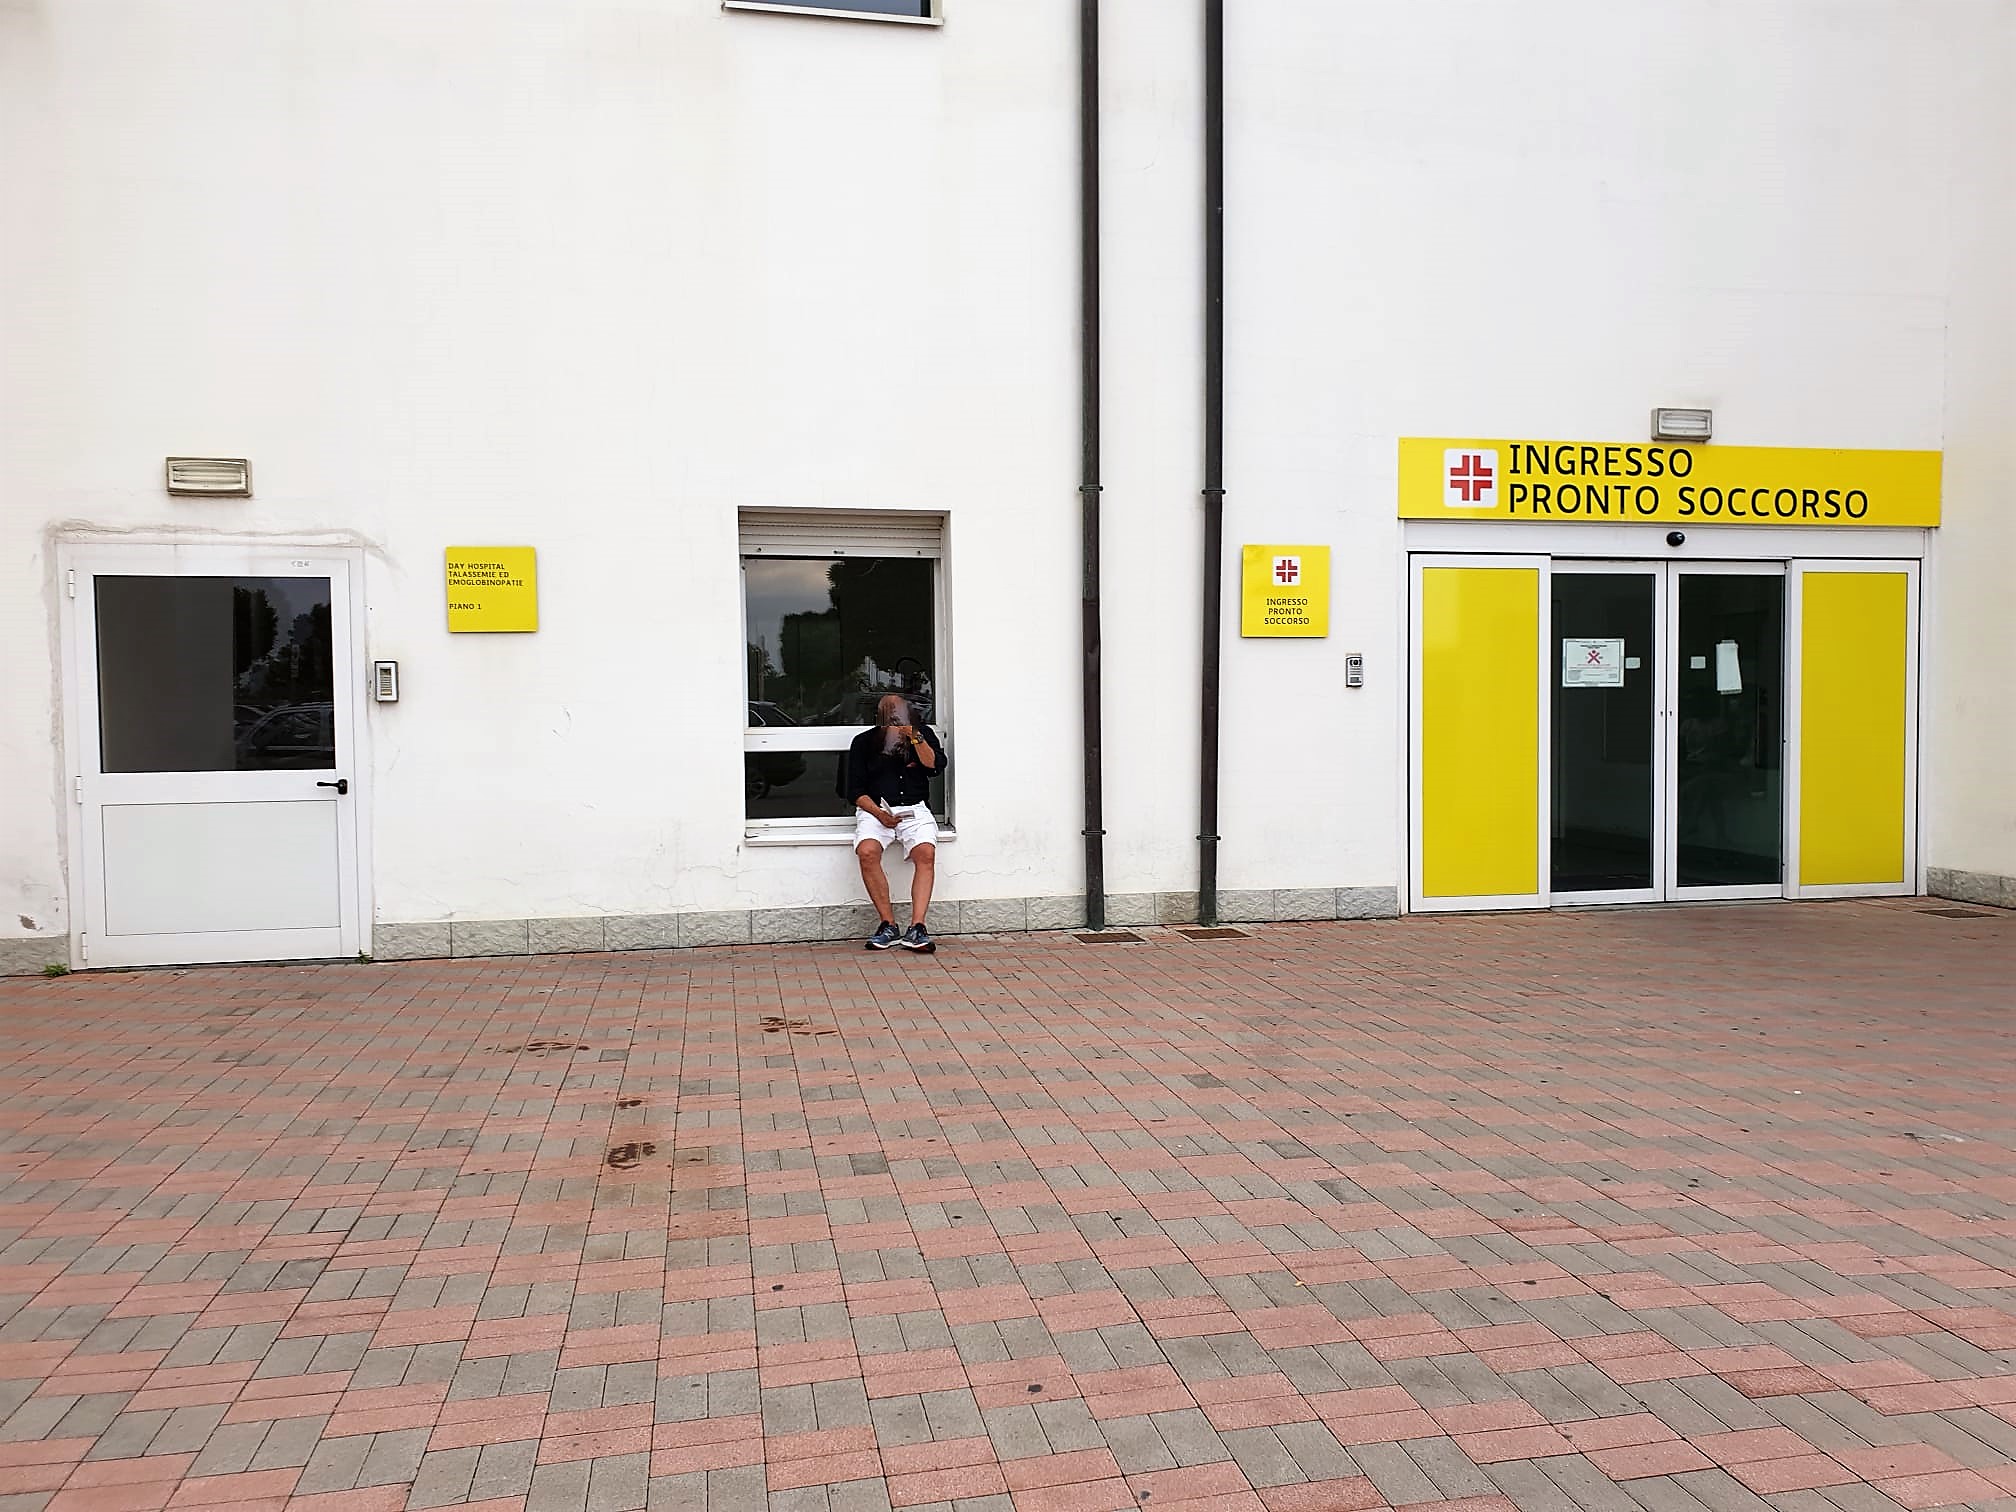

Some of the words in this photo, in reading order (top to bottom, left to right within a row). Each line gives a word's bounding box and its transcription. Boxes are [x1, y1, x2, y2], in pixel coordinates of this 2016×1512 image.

[1509, 444, 1693, 477] INGRESSO
[1509, 484, 1659, 514] PRONTO
[1679, 487, 1868, 518] SOCCORSO
[1266, 598, 1308, 606] INGRESSO
[1268, 607, 1303, 615] PRONTO
[1264, 617, 1310, 625] SOCCORSO
